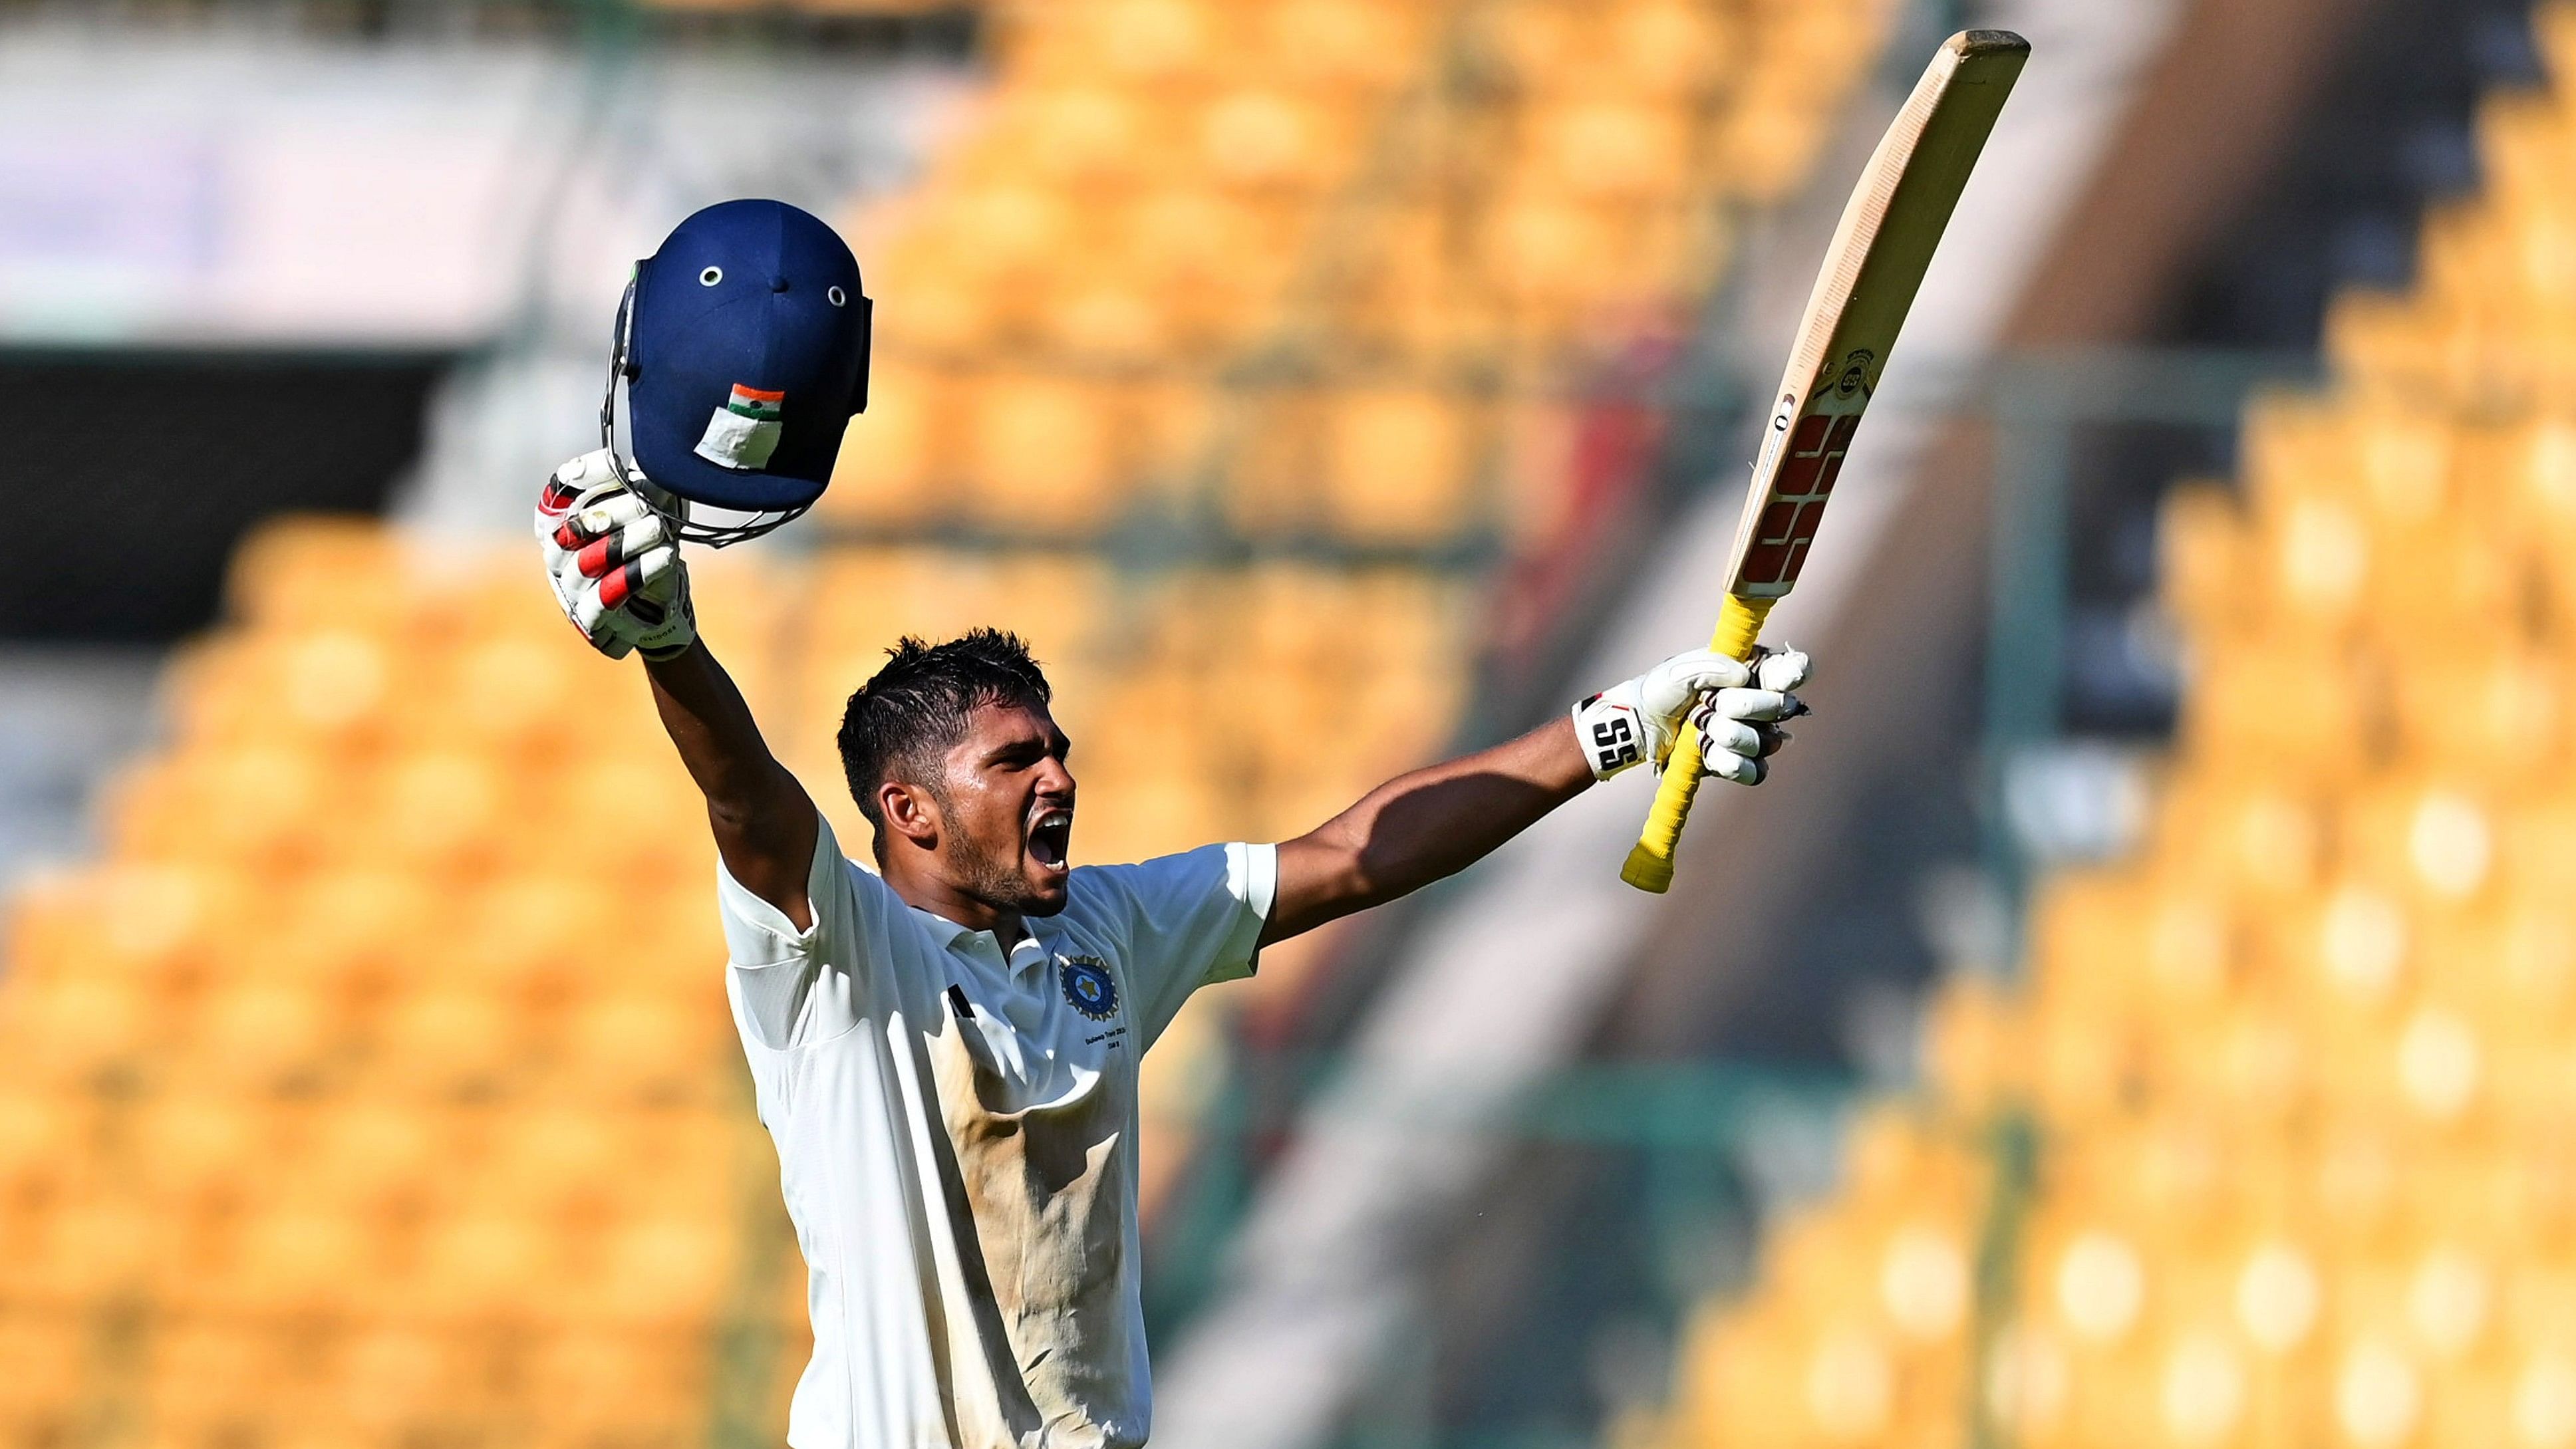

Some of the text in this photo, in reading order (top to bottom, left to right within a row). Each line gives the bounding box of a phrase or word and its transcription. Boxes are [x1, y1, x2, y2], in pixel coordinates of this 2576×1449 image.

[1843, 374, 1860, 386] SS
[1742, 415, 1862, 583] SS
[1592, 718, 1638, 771] SS
